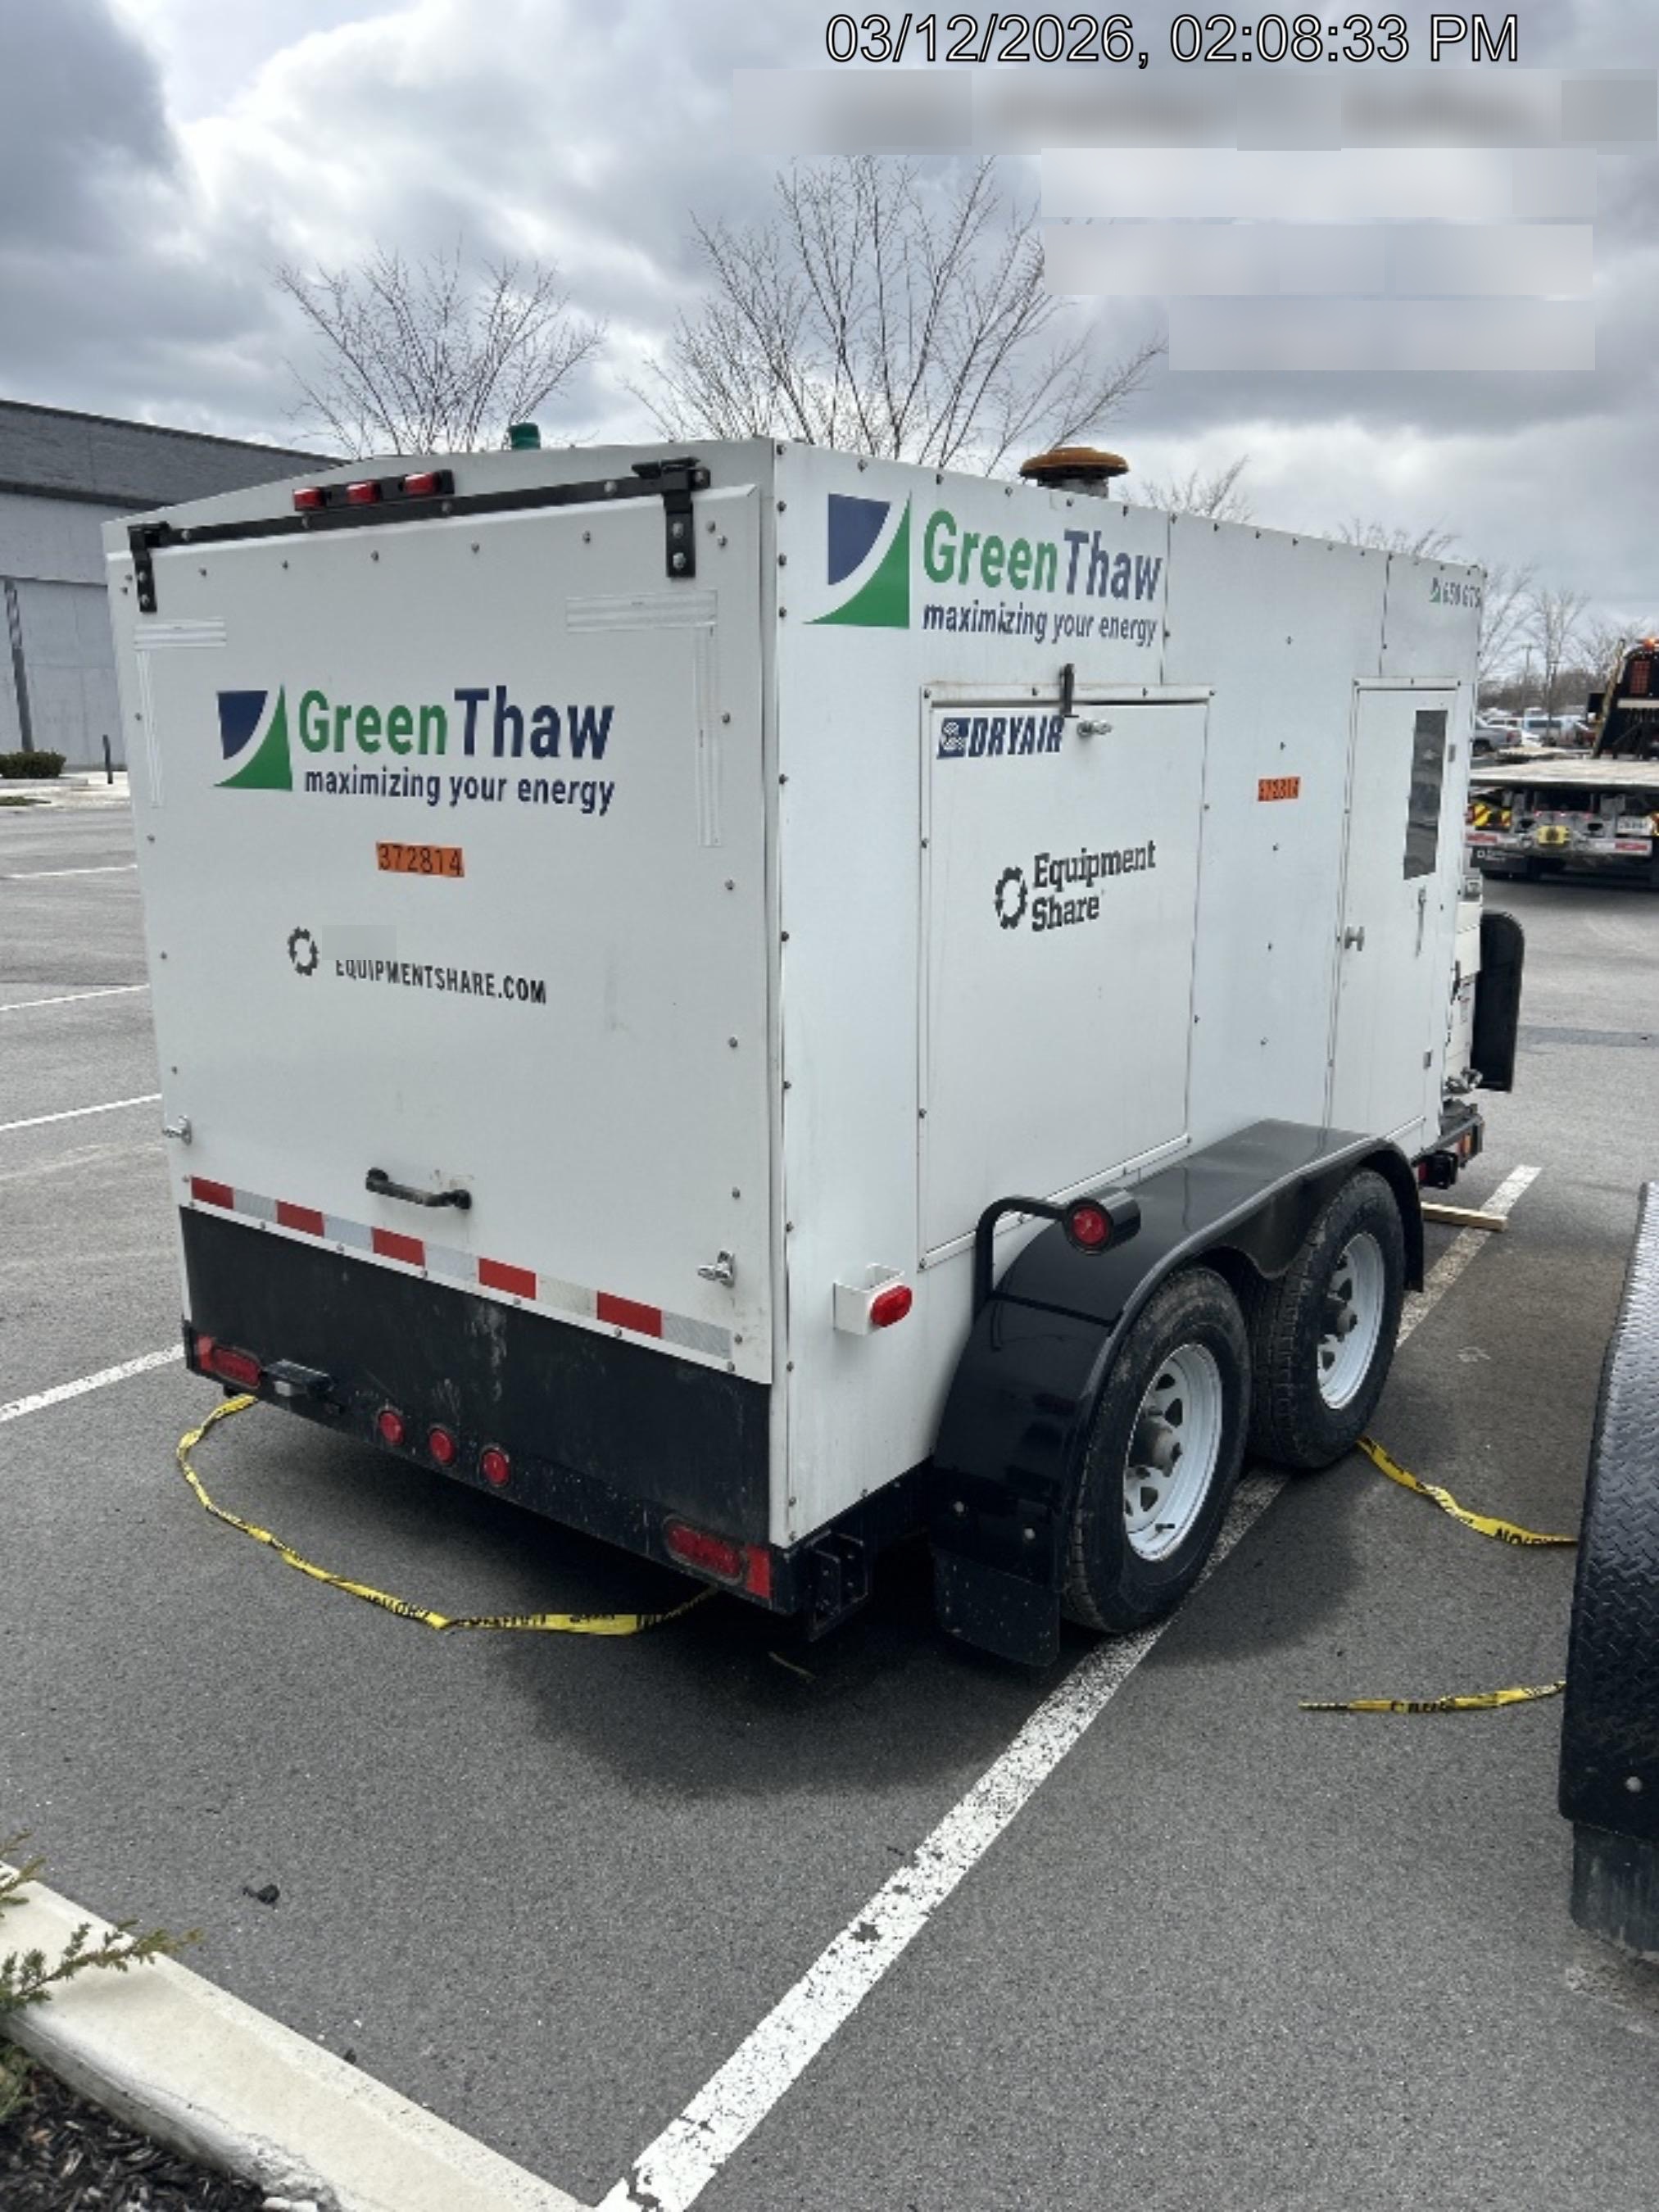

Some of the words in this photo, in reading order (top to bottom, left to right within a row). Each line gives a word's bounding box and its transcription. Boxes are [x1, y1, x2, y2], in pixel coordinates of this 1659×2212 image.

[923, 509, 1163, 601] GreenThaw
[922, 599, 1046, 644] maximizing
[1051, 614, 1095, 644] your
[1099, 616, 1157, 647] energy
[299, 685, 615, 759] GreenThaw
[968, 715, 1065, 758] DRYAIR
[304, 764, 441, 806] maximizing
[449, 776, 507, 806] your
[517, 777, 615, 816] energy
[378, 844, 464, 875] 372814
[1034, 840, 1156, 892] Equipment
[1032, 895, 1099, 931] Share
[335, 959, 547, 1004] EQUIPMENTSHARE.COM
